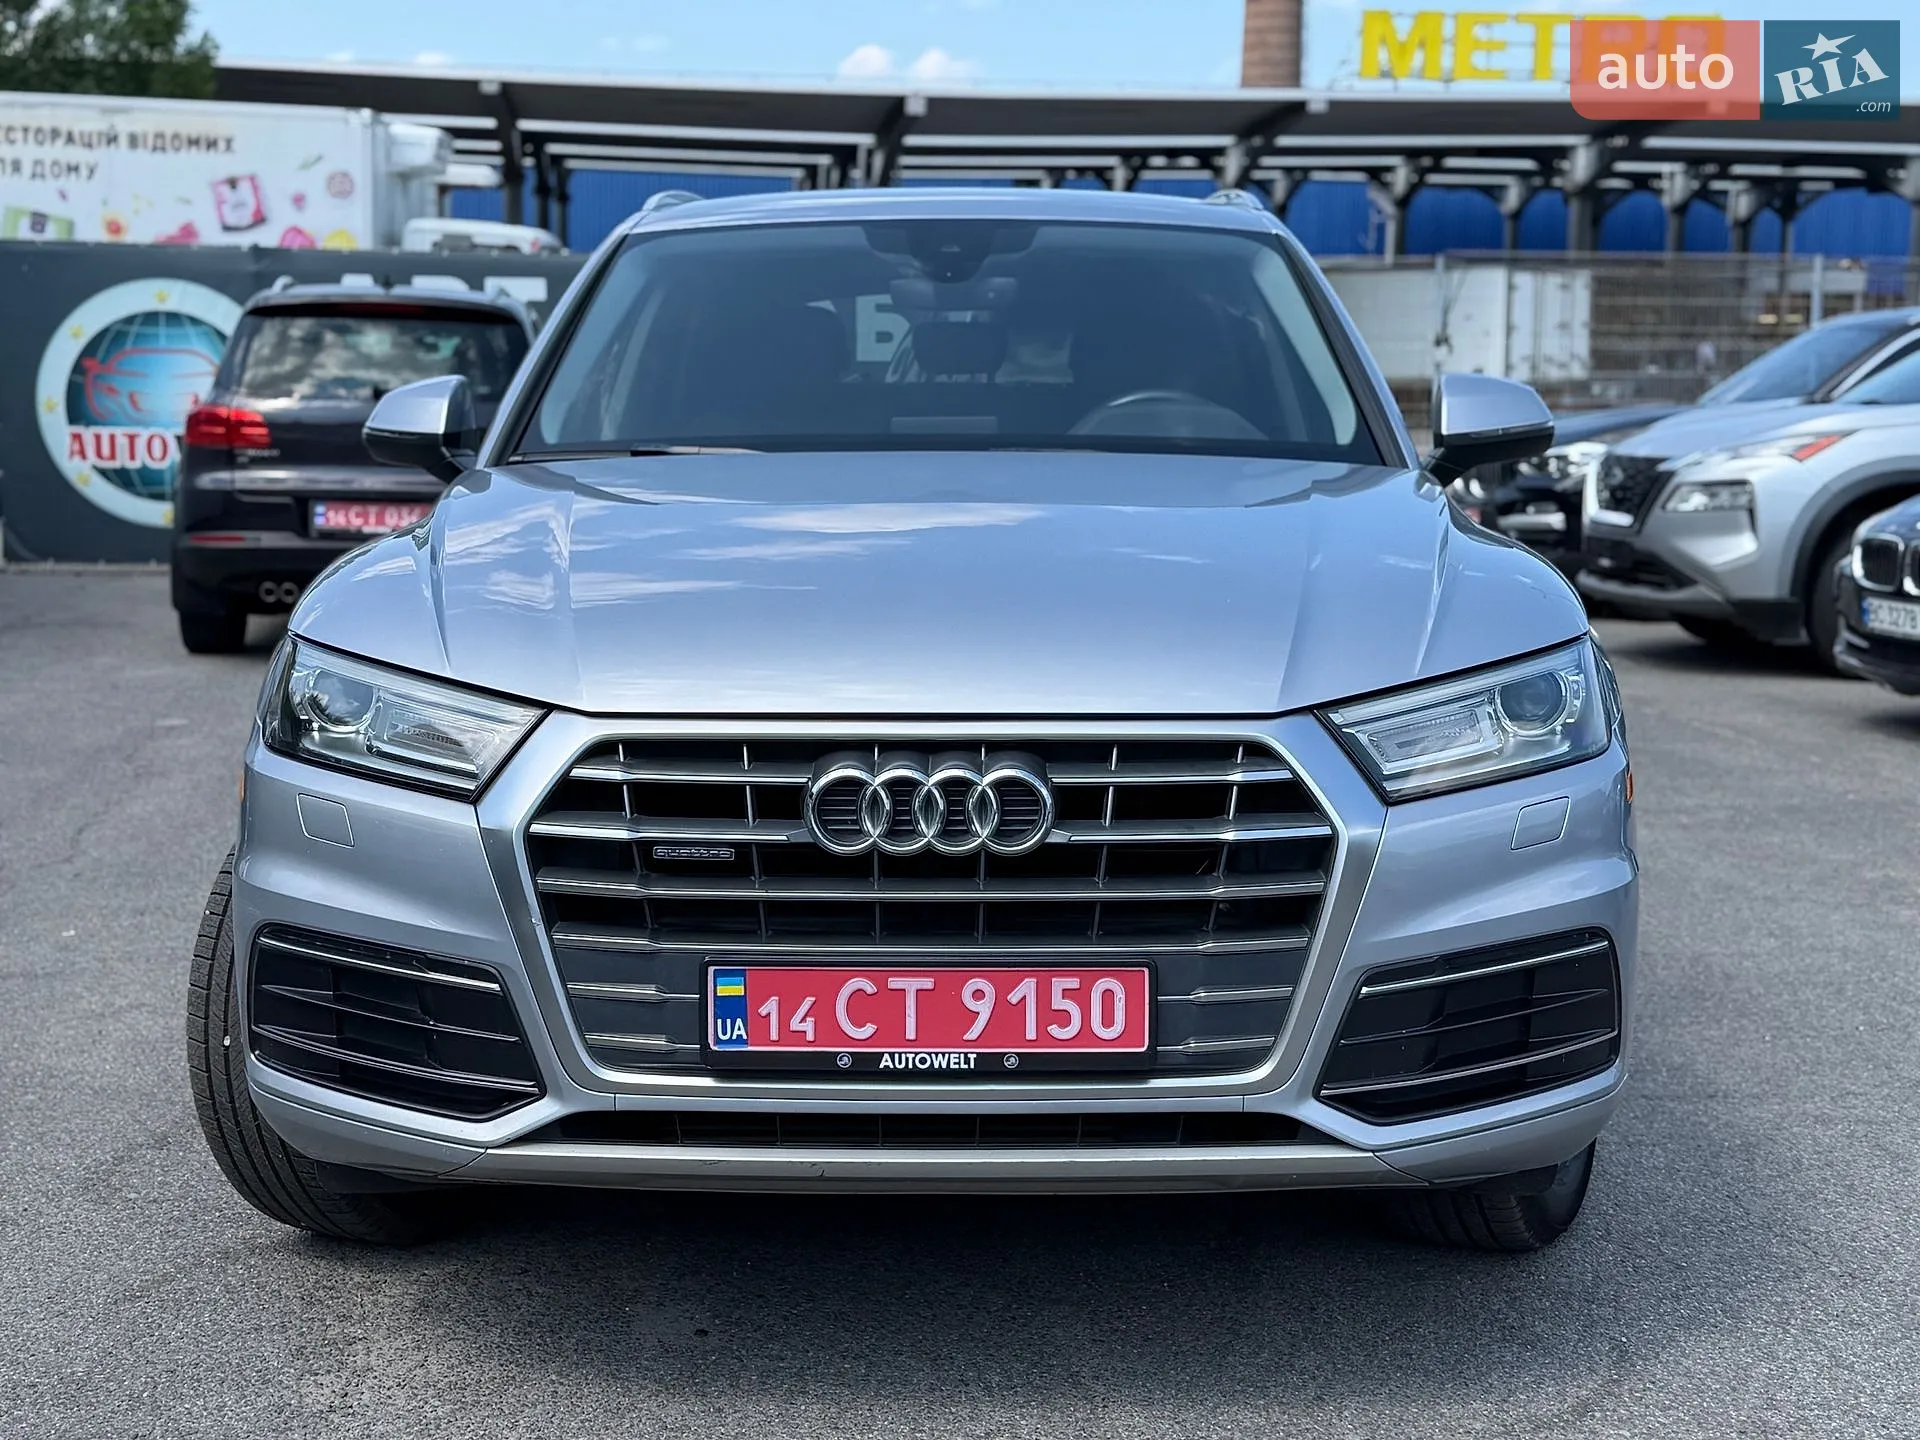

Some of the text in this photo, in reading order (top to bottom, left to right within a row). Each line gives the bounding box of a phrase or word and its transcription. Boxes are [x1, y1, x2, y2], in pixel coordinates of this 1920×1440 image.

[0, 123, 235, 153] СТОРАЦІЙ ВІДОМИХ
[30, 158, 99, 180] ДОМУ
[654, 847, 733, 859] quattro
[716, 977, 1126, 1042] UA 14 CT 9150
[878, 1053, 977, 1070] AUTOWELT
